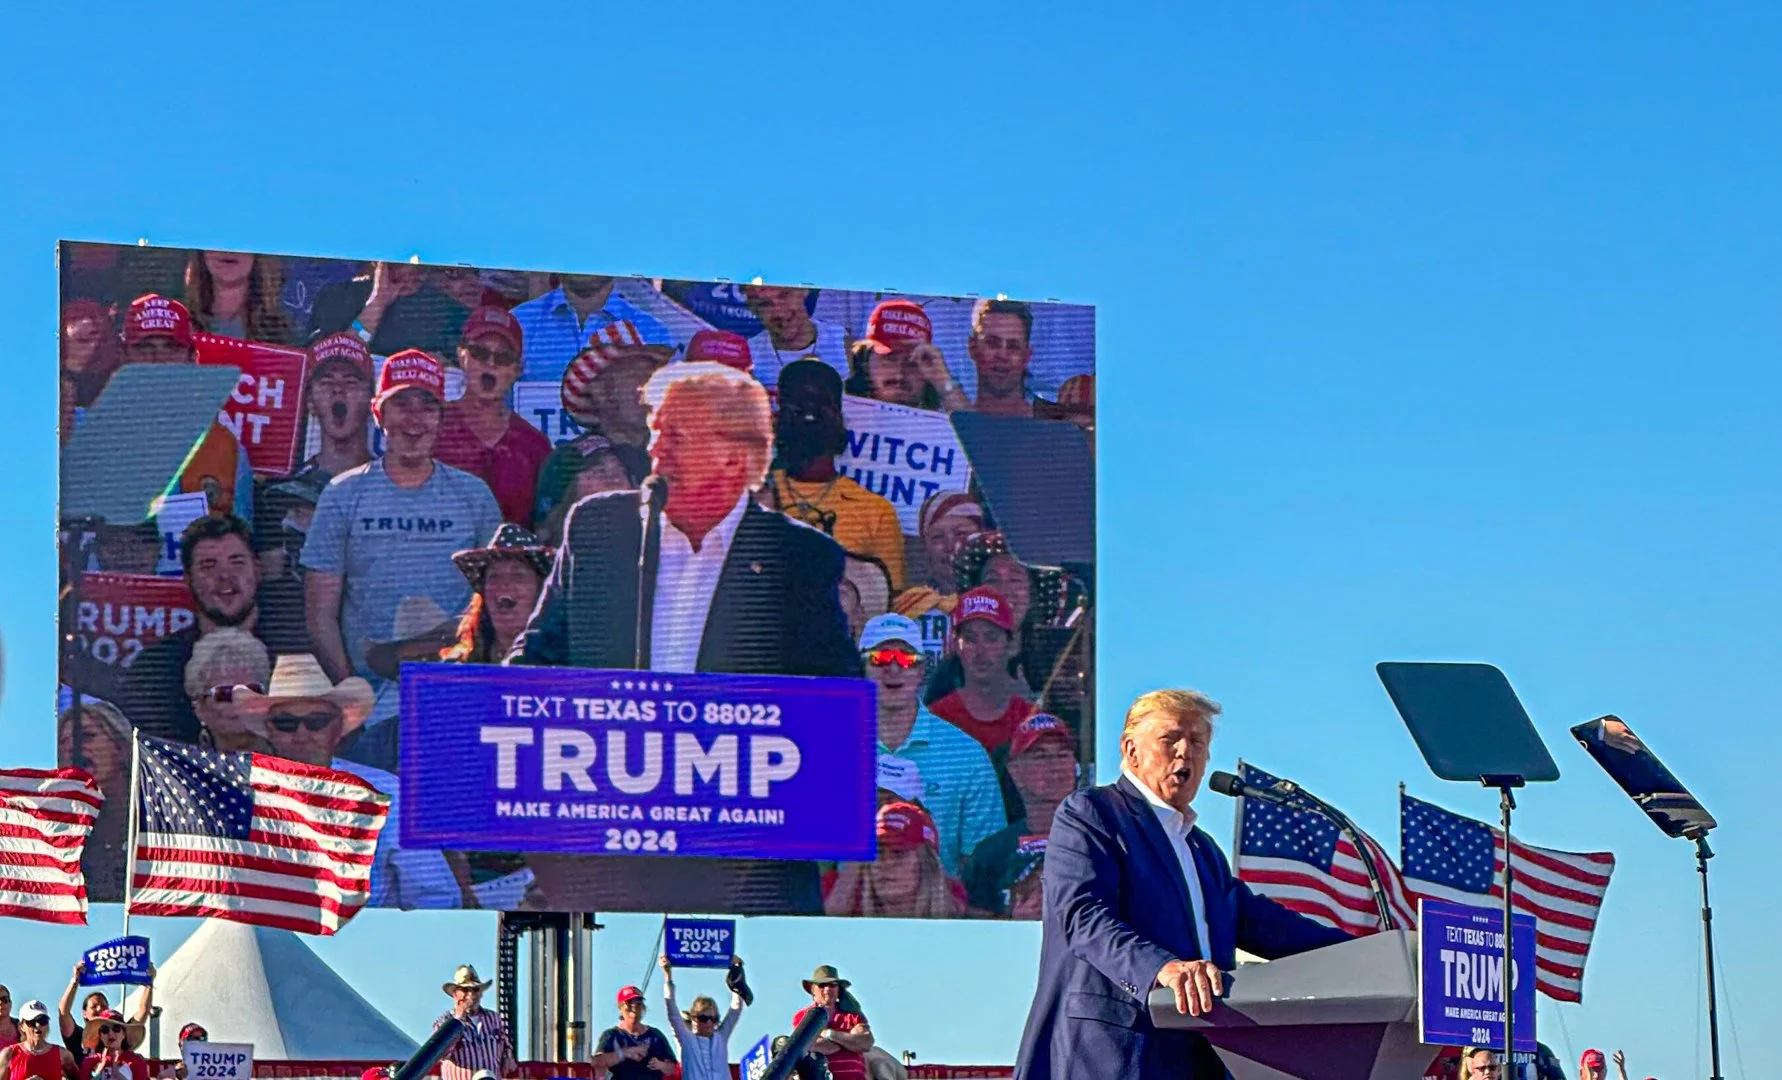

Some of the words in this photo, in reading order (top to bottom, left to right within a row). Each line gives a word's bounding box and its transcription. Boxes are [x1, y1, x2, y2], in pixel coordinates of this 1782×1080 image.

[144, 299, 169, 309] KEEP
[135, 309, 180, 321] AMERICA
[141, 319, 175, 330] GREAT
[361, 517, 453, 533] TRUMP
[501, 695, 566, 717] TEXT
[573, 698, 657, 722] TEXAS
[663, 701, 697, 722] TO
[703, 702, 781, 726] 88022
[480, 725, 801, 798] TRUMP
[496, 801, 551, 817] MAKE
[557, 803, 644, 820] AMERICA
[650, 806, 712, 822] GREAT
[718, 808, 785, 825] AGAIN!
[604, 828, 678, 851] 2024
[671, 928, 730, 941] TRUMP
[1446, 925, 1463, 943] TEXT
[1463, 928, 1484, 947] TEXAS
[1485, 931, 1494, 948] TO
[88, 945, 145, 962] TRUMP
[680, 940, 722, 953] 2024
[95, 957, 138, 972] 2024
[1445, 1006, 1460, 1018] MAKE
[1460, 1008, 1482, 1020] AMERICA
[1482, 1010, 1498, 1022] GREAT
[1472, 1027, 1490, 1043] 2024
[190, 1052, 246, 1065] TRUMP
[196, 1065, 237, 1077] 2024
